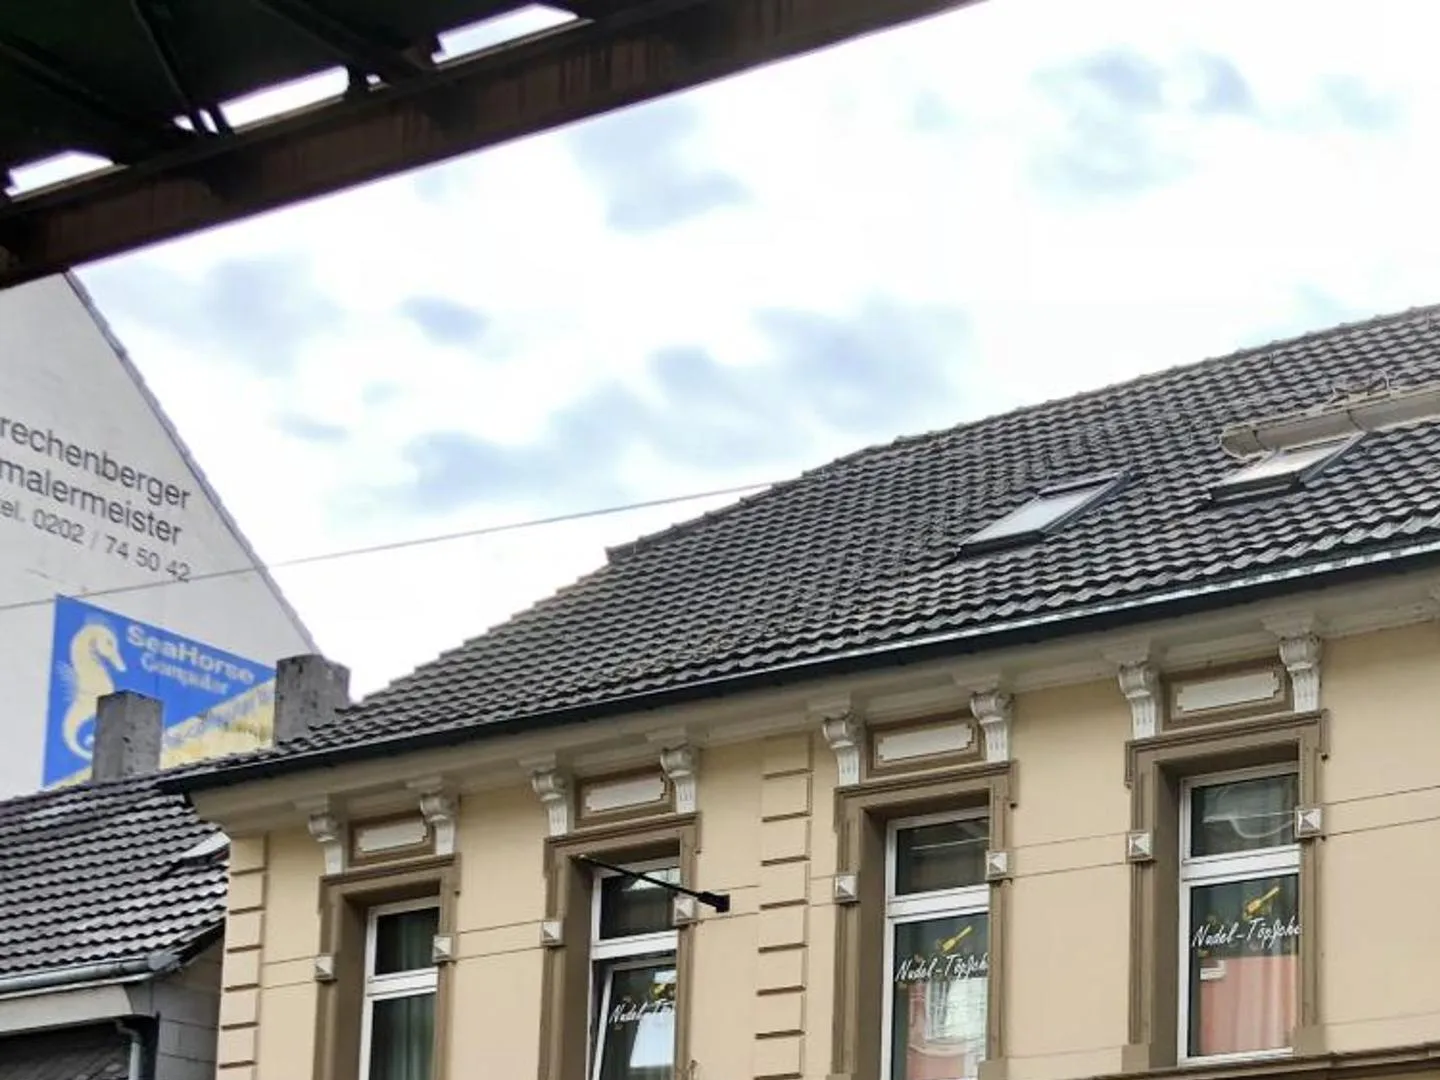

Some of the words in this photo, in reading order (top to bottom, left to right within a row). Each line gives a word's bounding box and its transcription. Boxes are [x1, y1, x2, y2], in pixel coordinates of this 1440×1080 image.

[0, 458, 183, 546] malermeister
[33, 508, 85, 545] 0202
[105, 534, 130, 560] 74
[136, 547, 161, 572] 50
[166, 560, 191, 583] 42
[127, 624, 255, 685] SeaHorse
